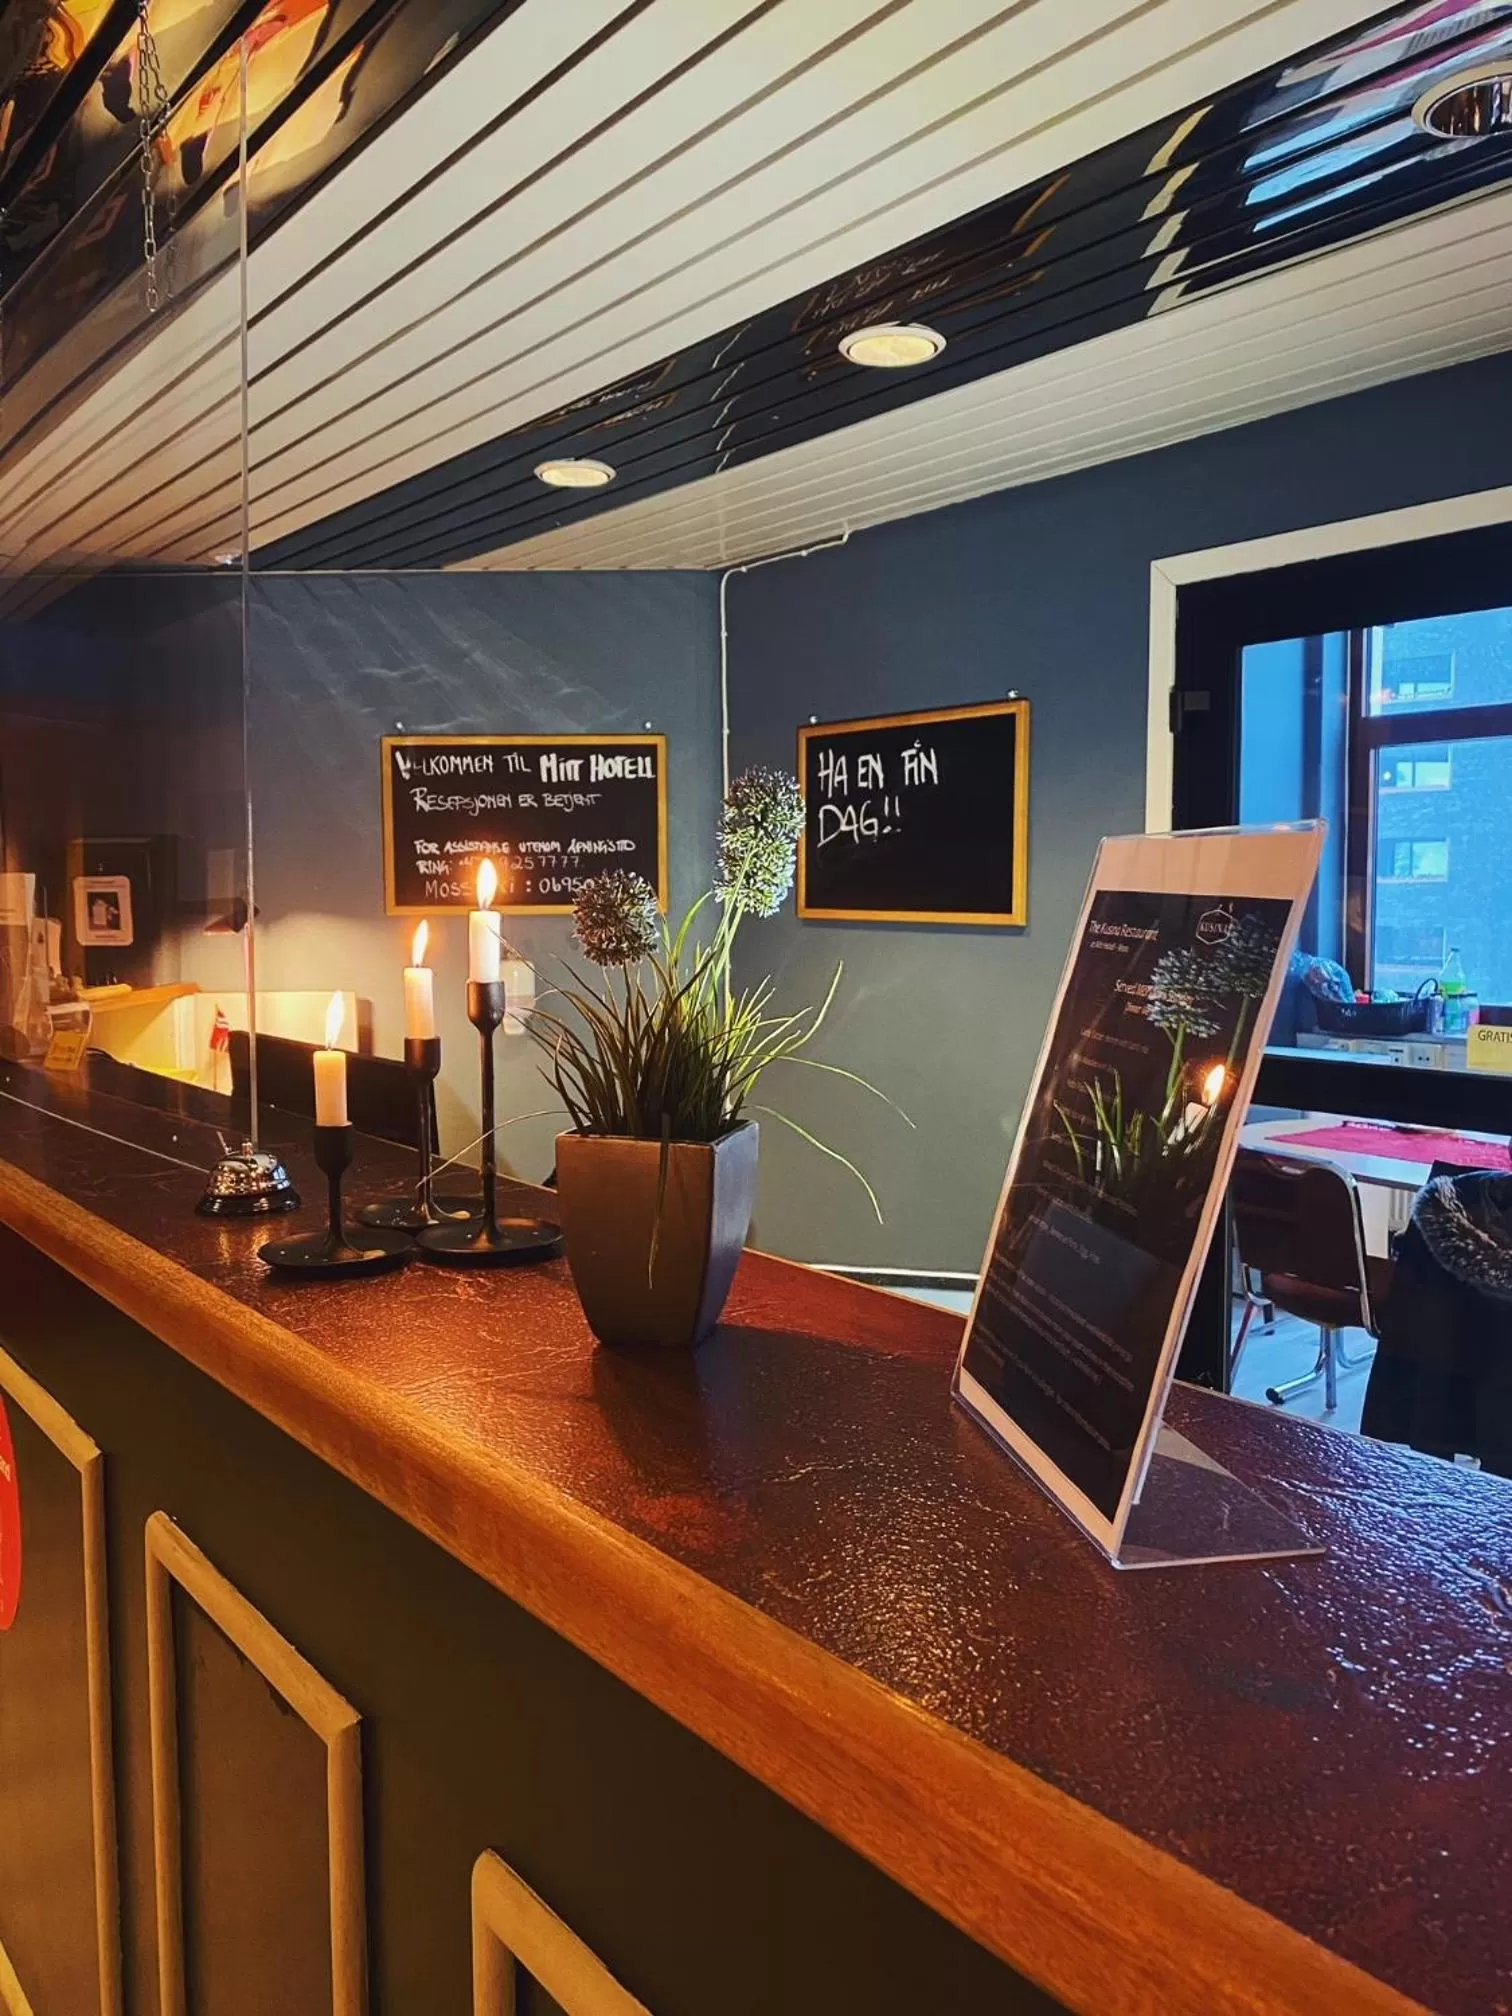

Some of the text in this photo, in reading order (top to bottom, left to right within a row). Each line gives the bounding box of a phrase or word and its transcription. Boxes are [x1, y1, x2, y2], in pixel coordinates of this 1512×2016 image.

[818, 748, 849, 799] HA
[857, 753, 885, 790] EN
[518, 793, 538, 808] ER
[413, 839, 440, 855] FOR
